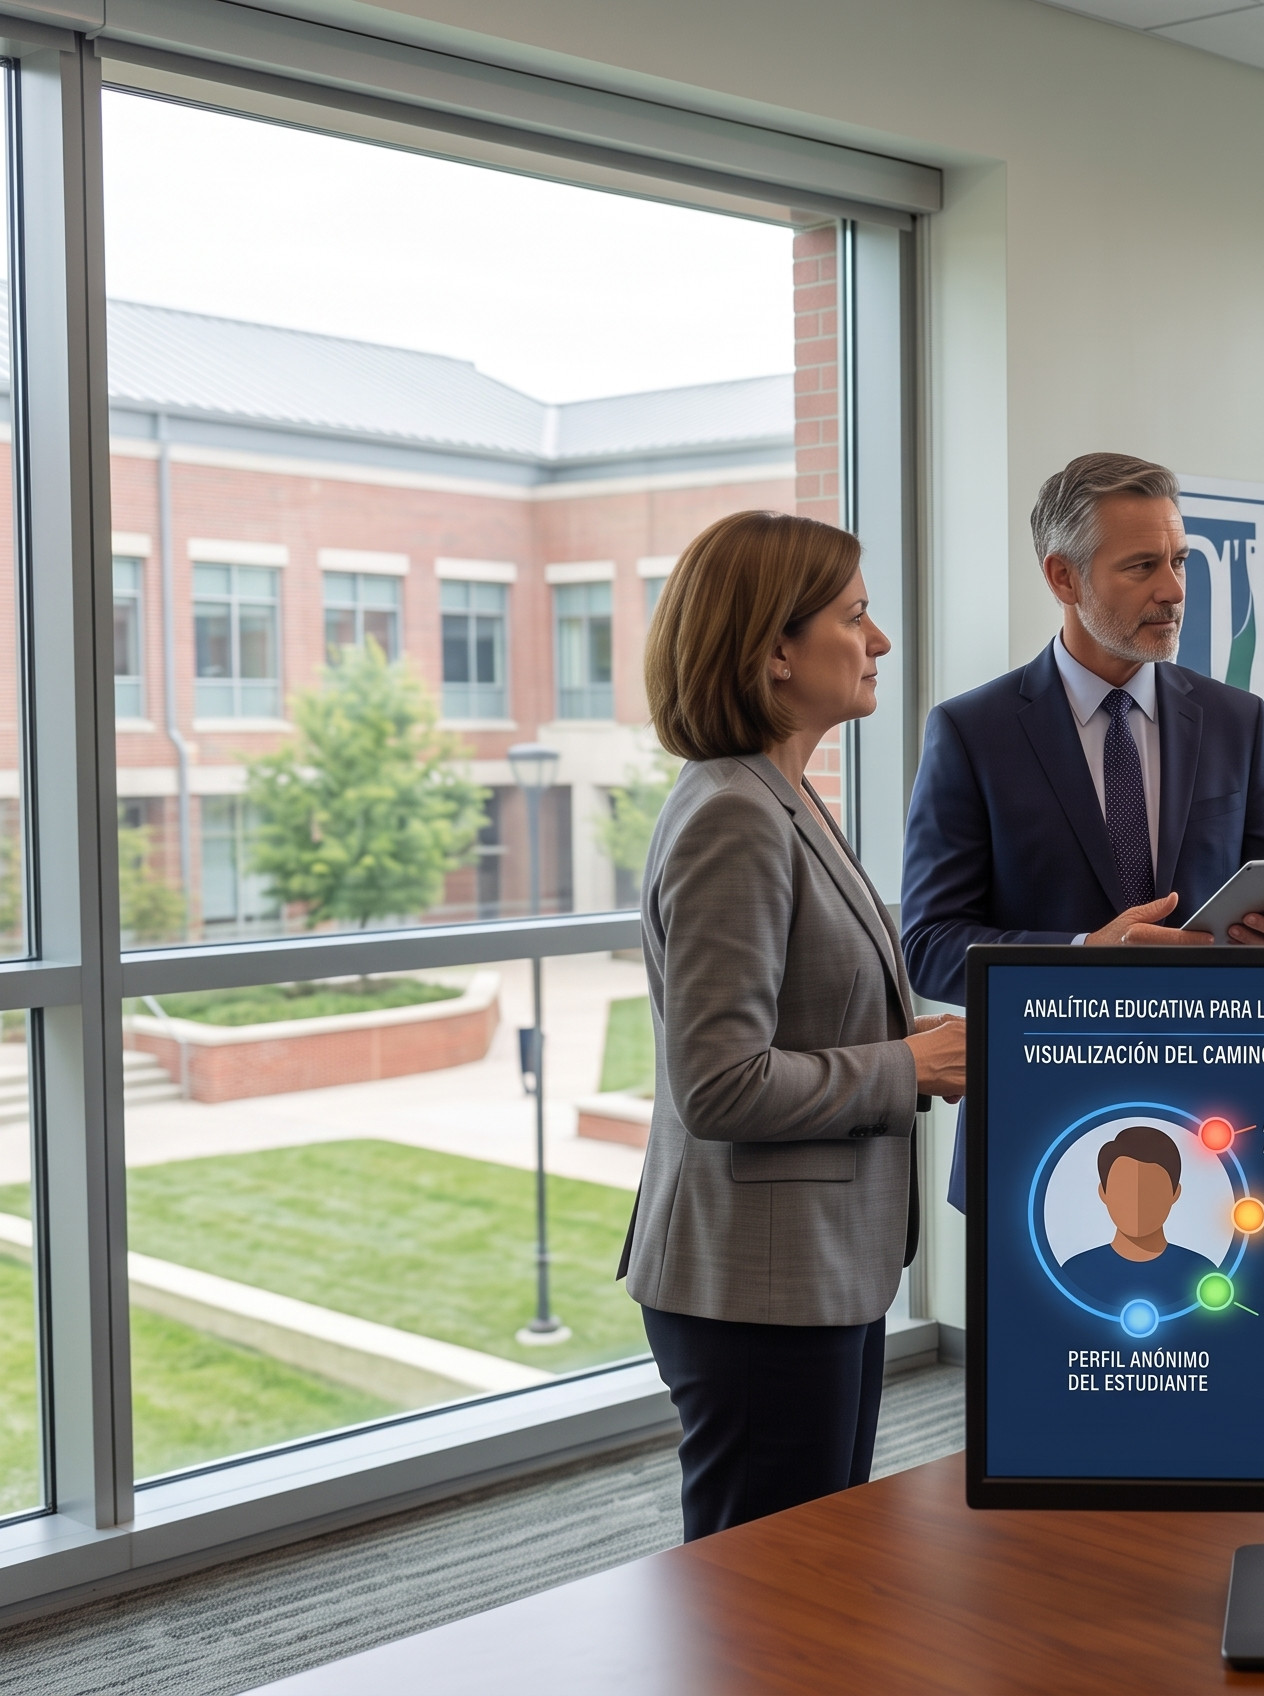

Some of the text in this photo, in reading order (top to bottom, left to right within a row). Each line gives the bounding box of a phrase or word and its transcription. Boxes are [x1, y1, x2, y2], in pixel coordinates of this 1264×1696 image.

[1023, 994, 1110, 1018] ANALÍTICA
[1115, 999, 1205, 1019] EDUCATIVA
[1210, 999, 1253, 1019] PARA
[1023, 1040, 1159, 1065] VISUALIZACIÓN
[1165, 1045, 1198, 1064] DEL
[1068, 1346, 1210, 1369] PERFIL ANÓNIMO
[1068, 1374, 1209, 1392] DEL ESTUDIANTE
